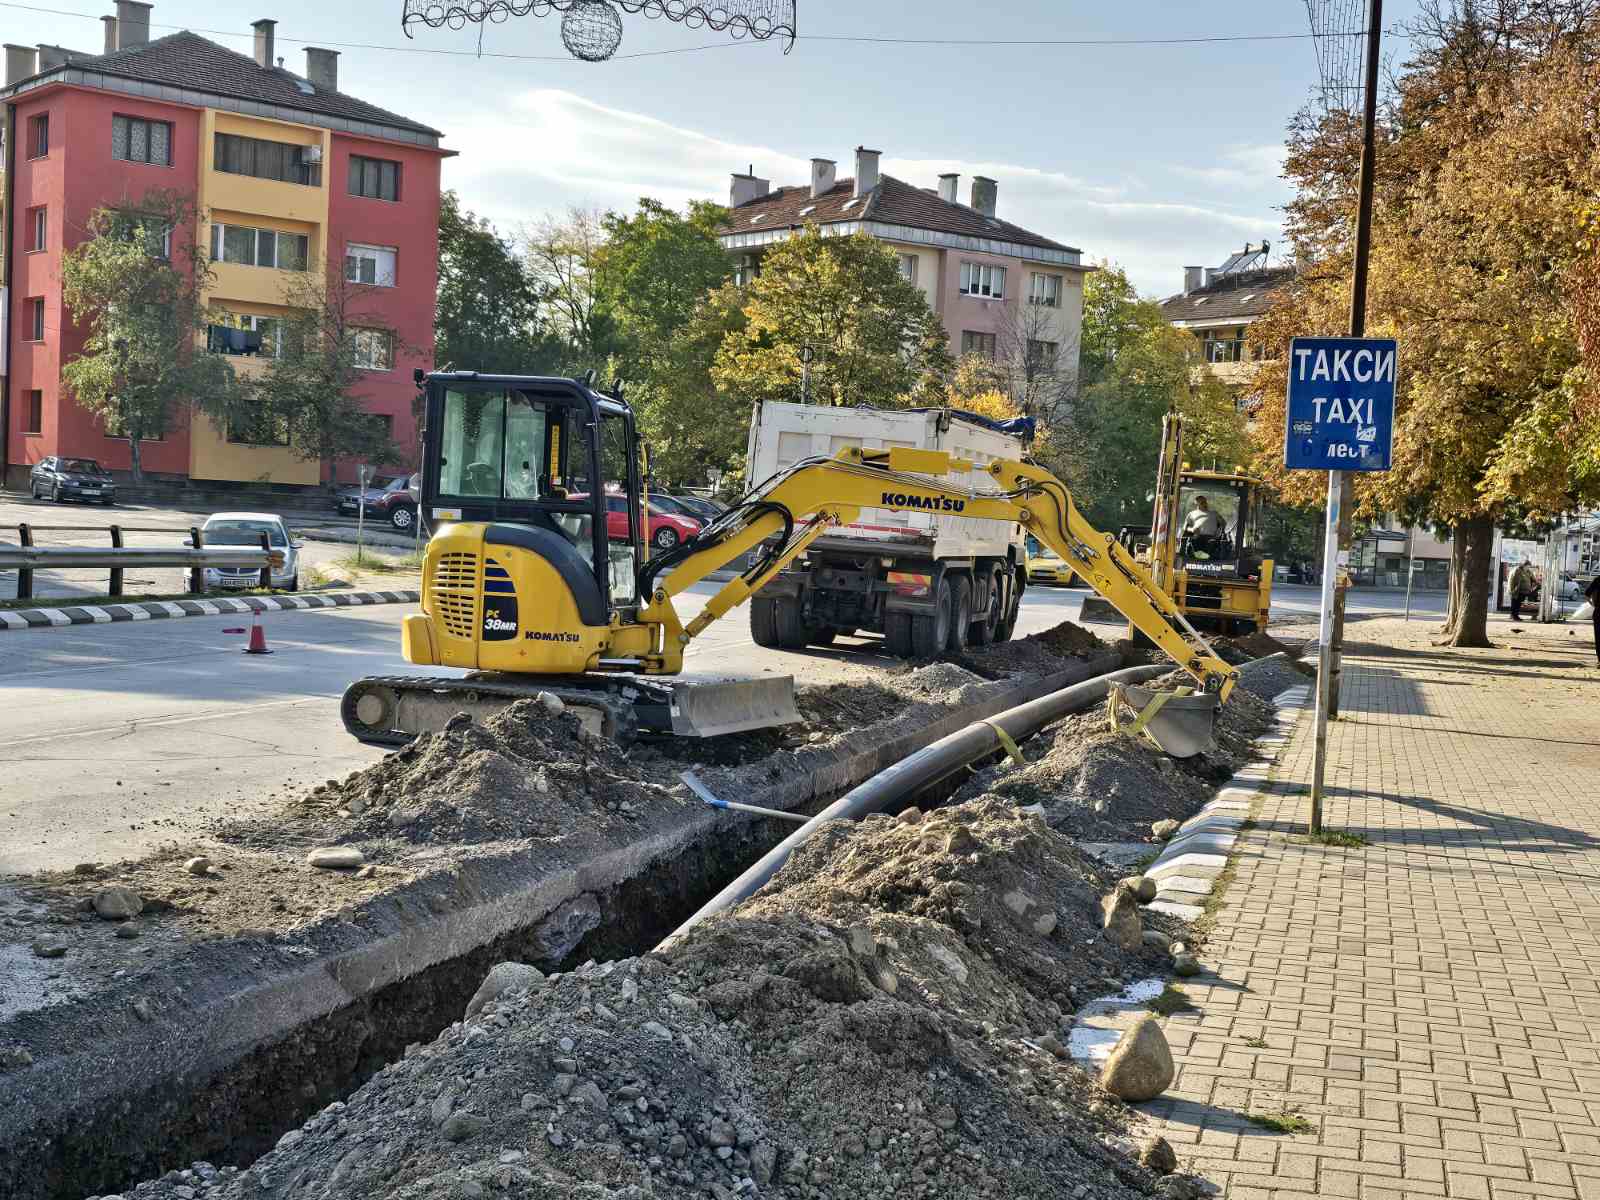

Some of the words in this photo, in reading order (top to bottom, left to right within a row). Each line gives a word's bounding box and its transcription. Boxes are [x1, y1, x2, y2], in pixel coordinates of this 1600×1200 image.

[1295, 349, 1394, 382] ТАКСИ
[1312, 398, 1374, 424] TAXI
[881, 492, 965, 512] KOMATSU
[486, 609, 500, 618] PC
[484, 618, 517, 631] 38MR
[525, 631, 580, 642] KOMATSU
